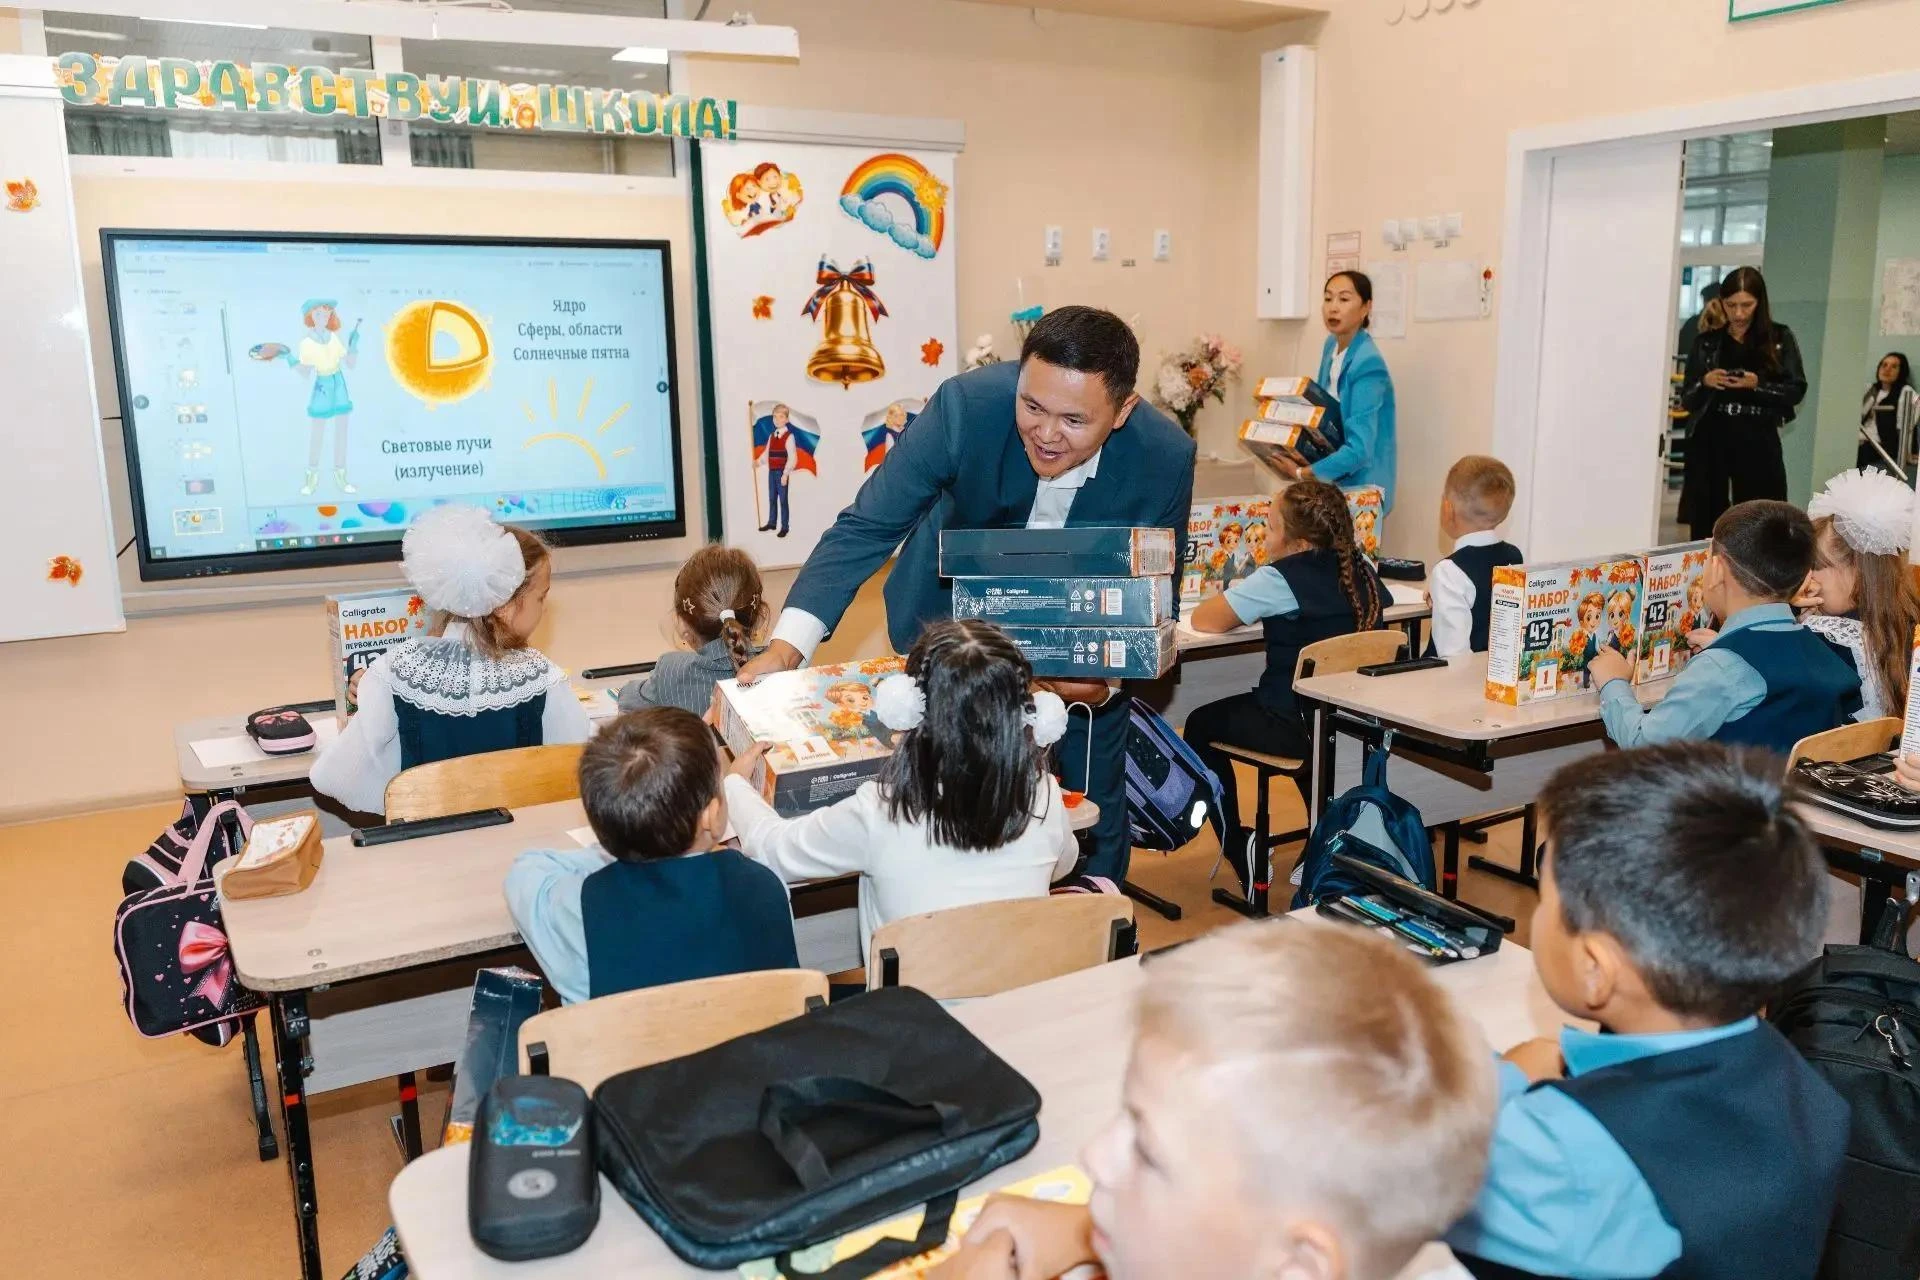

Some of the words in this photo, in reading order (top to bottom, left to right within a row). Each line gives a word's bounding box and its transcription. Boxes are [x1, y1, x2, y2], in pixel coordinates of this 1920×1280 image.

[539, 84, 737, 141] ШКОЛА!
[553, 299, 586, 316] Ядро
[518, 322, 565, 339] Сферы,
[568, 322, 623, 337] области
[513, 347, 588, 361] Солнечные
[591, 347, 630, 361] пятна
[381, 439, 452, 454] Световые
[456, 438, 492, 455] лучи
[394, 460, 484, 482] (излучение)
[1649, 573, 1682, 592] НАБОР
[1528, 589, 1570, 609] НАБОР
[342, 606, 386, 618] Calligrata
[1649, 603, 1664, 621] 42
[344, 617, 409, 640] НАБОР
[1530, 621, 1549, 640] 42
